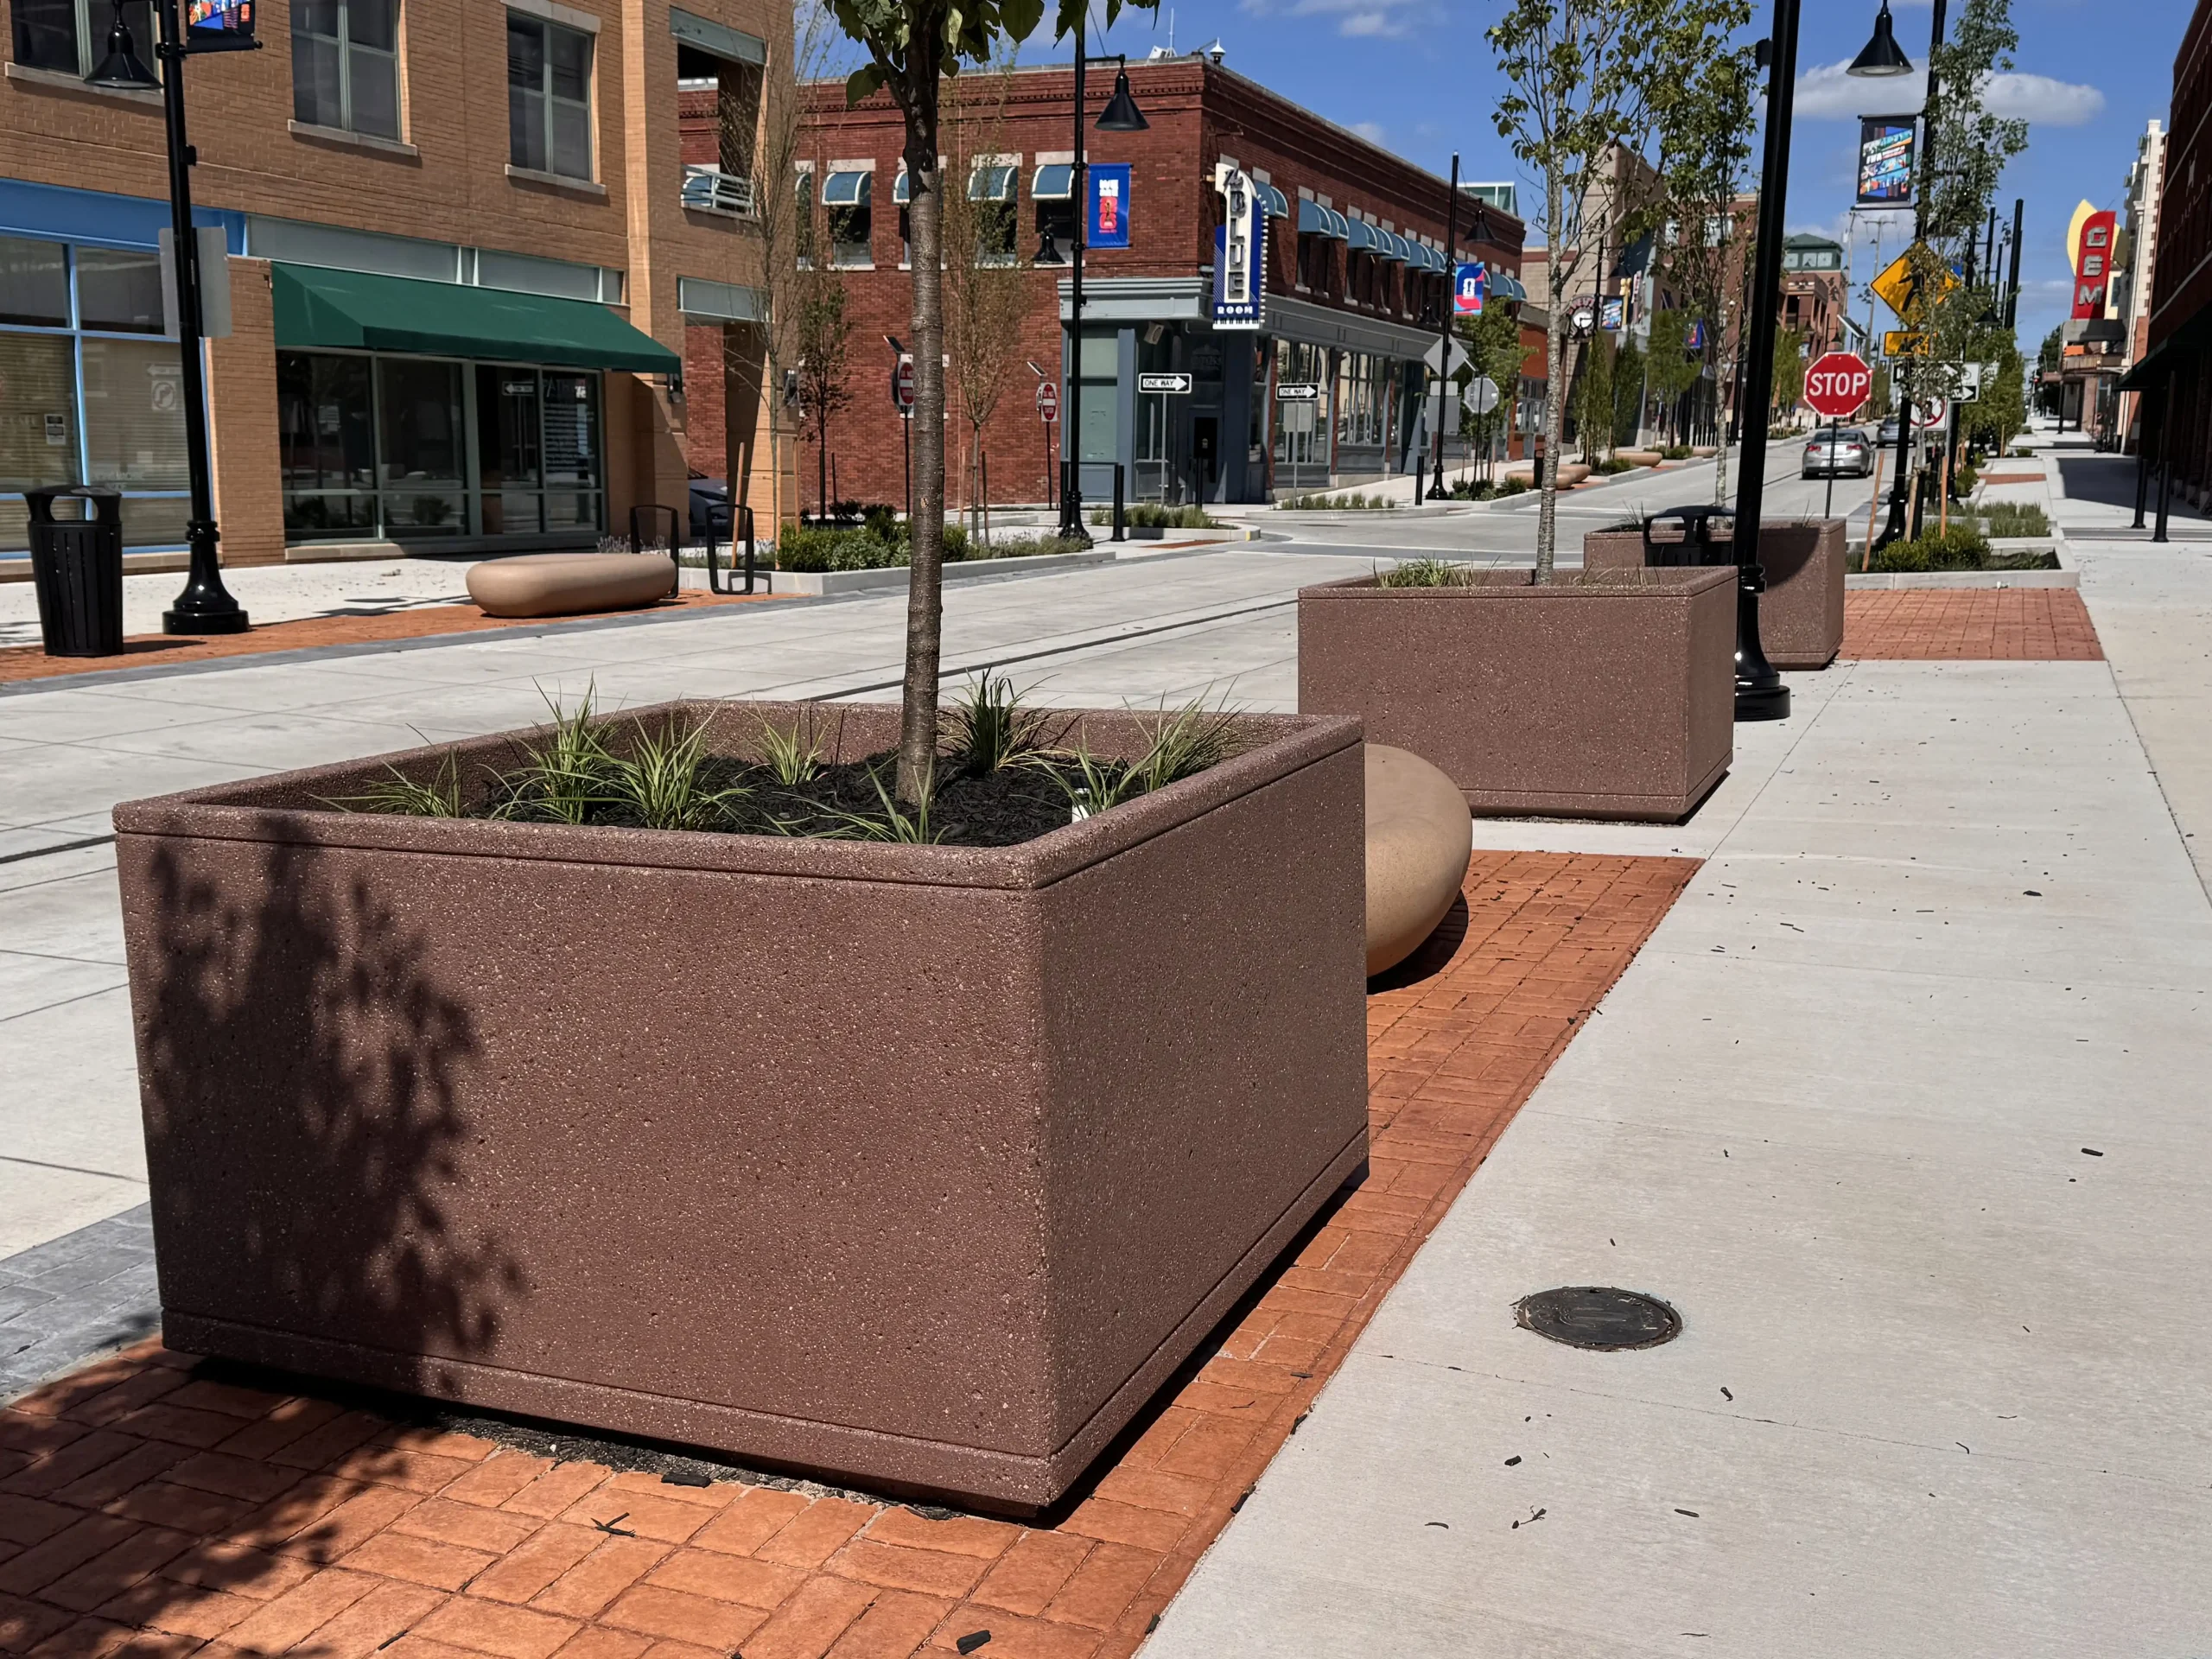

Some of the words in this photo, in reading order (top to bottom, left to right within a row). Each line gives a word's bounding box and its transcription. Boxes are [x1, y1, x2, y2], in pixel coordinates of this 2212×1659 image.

[1228, 190, 1247, 300] BLUE
[2078, 226, 2107, 305] GEM
[1217, 306, 1253, 315] ROOM
[1808, 372, 1867, 397] STOP
